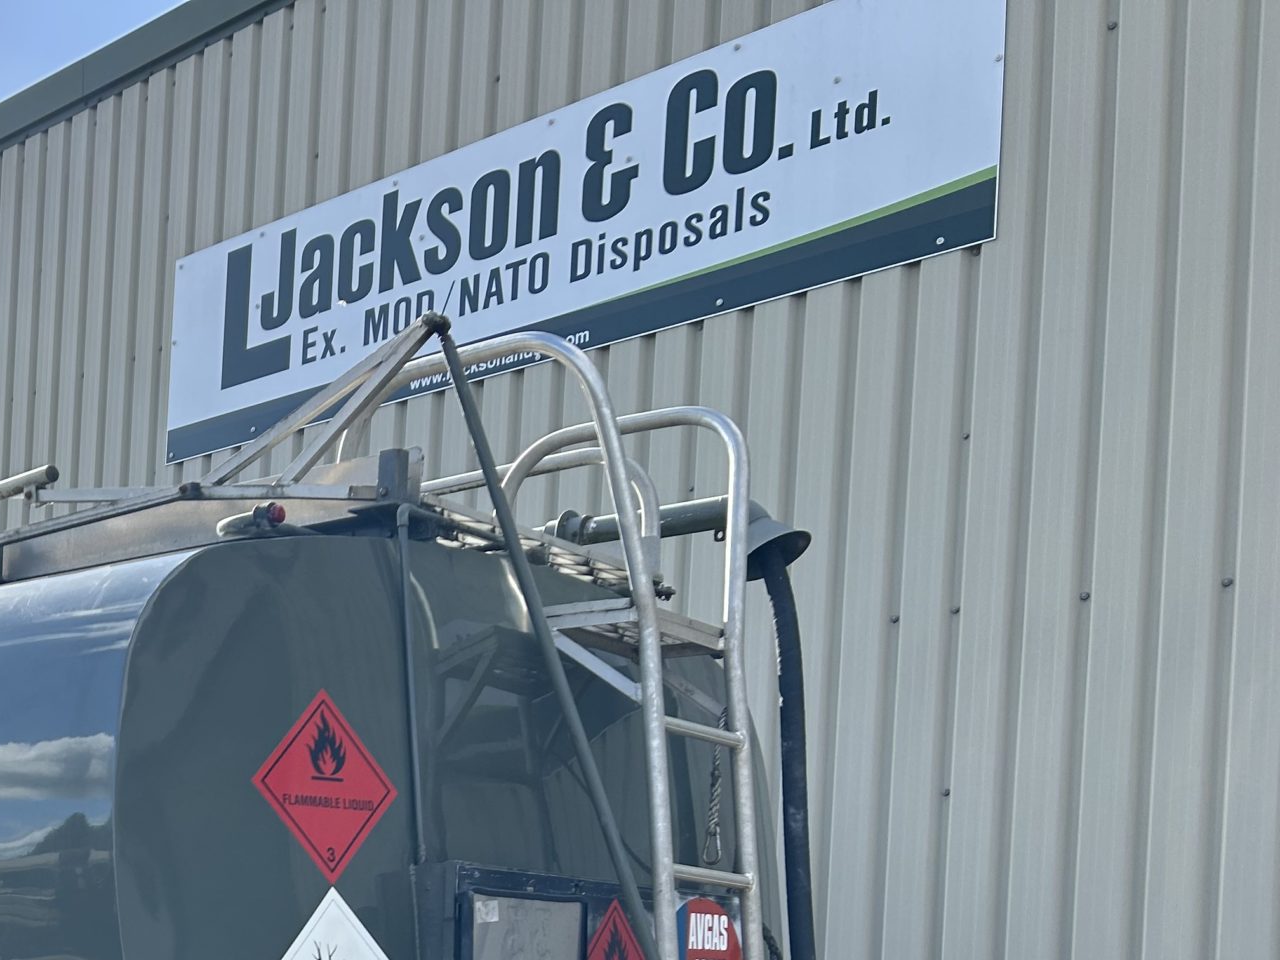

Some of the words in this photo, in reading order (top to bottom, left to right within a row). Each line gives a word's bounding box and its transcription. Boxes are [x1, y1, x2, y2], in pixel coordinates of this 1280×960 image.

[582, 102, 639, 222] &
[663, 69, 794, 195] Co.
[810, 89, 891, 149] Ltd.
[301, 326, 346, 365] Ex.
[570, 187, 771, 283] Disposals
[282, 793, 341, 809] FLAMMABLE
[343, 798, 375, 812] LIQUID
[326, 847, 336, 862] 3
[688, 912, 729, 951] AVGAS
